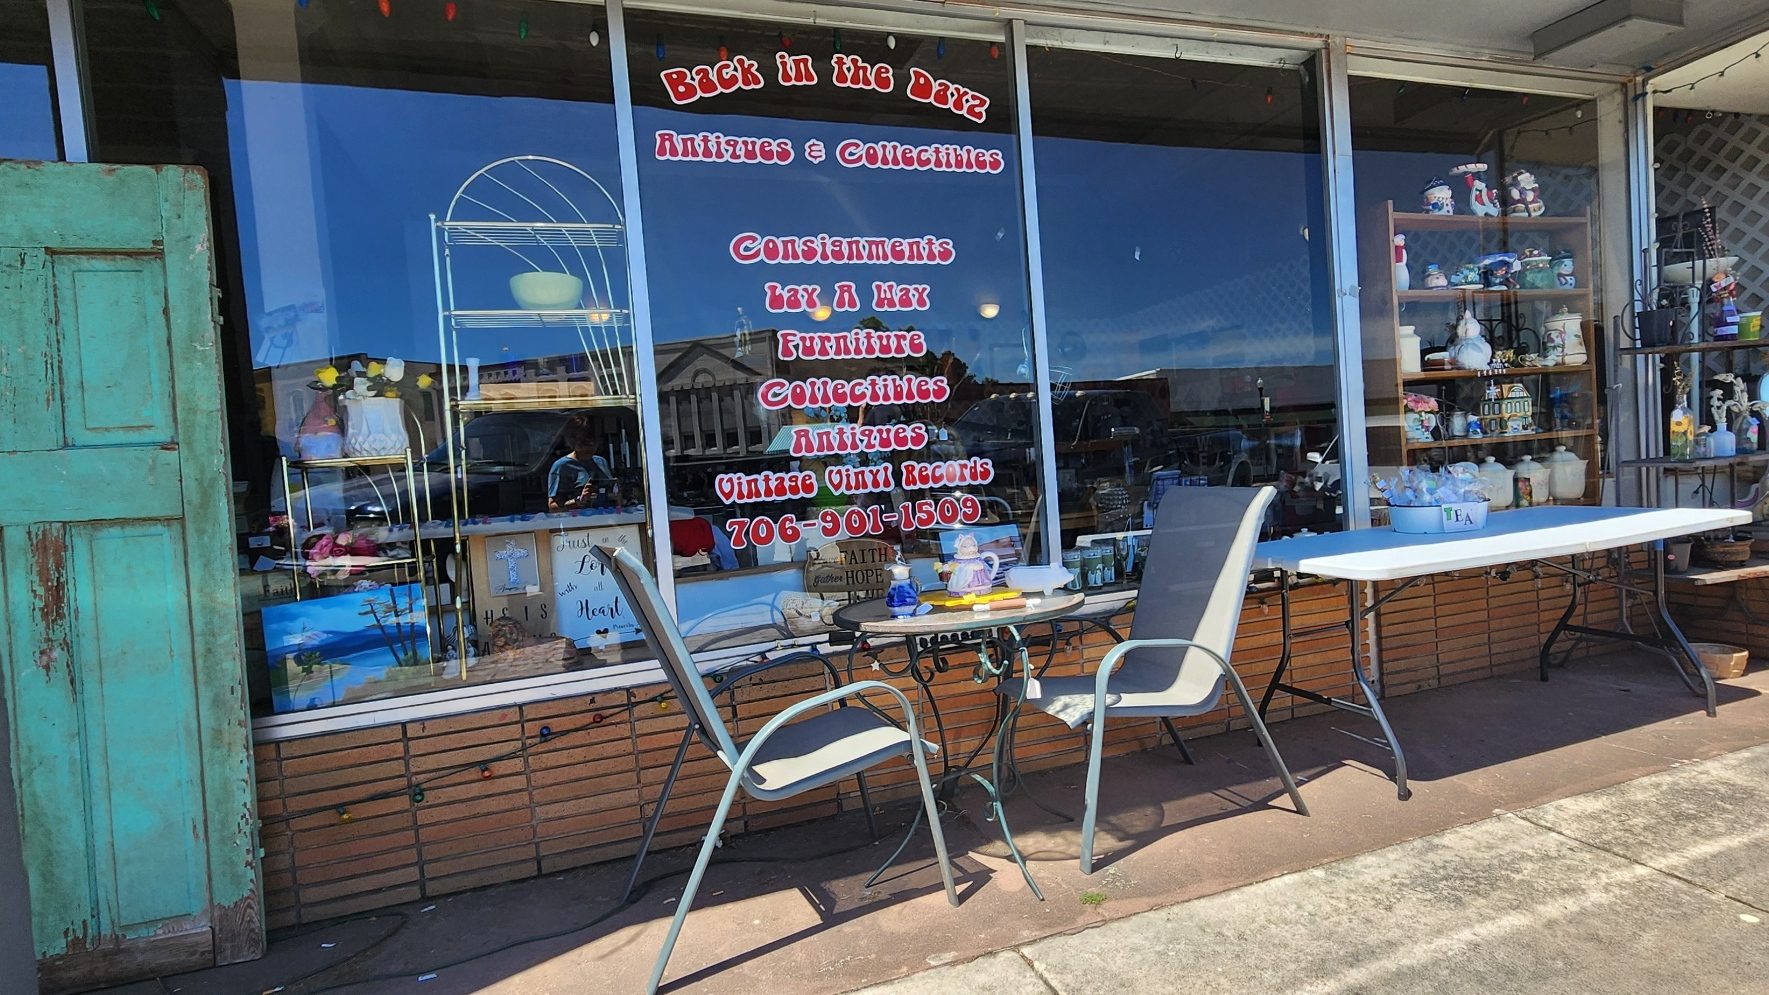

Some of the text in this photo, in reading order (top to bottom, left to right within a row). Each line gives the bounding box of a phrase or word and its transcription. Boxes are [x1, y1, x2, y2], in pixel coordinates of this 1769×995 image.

[661, 51, 990, 123] Back in the Dayz
[655, 130, 1004, 174] Antiques & Collectibles
[730, 232, 955, 265] Consignments
[764, 281, 930, 313] Lay A Way
[777, 329, 927, 360] Furniture
[757, 374, 950, 410] Collectibles
[790, 423, 928, 457] Antiques
[715, 456, 994, 504] Vintage Vinyl Records
[726, 494, 981, 549] 706-901-1509
[1444, 507, 1474, 526] TEA
[553, 532, 593, 552] Trust
[840, 547, 888, 565] FAITH
[575, 554, 606, 576] Lor
[845, 569, 884, 585] HOPE
[558, 581, 604, 597] with all
[576, 596, 623, 620] Heart
